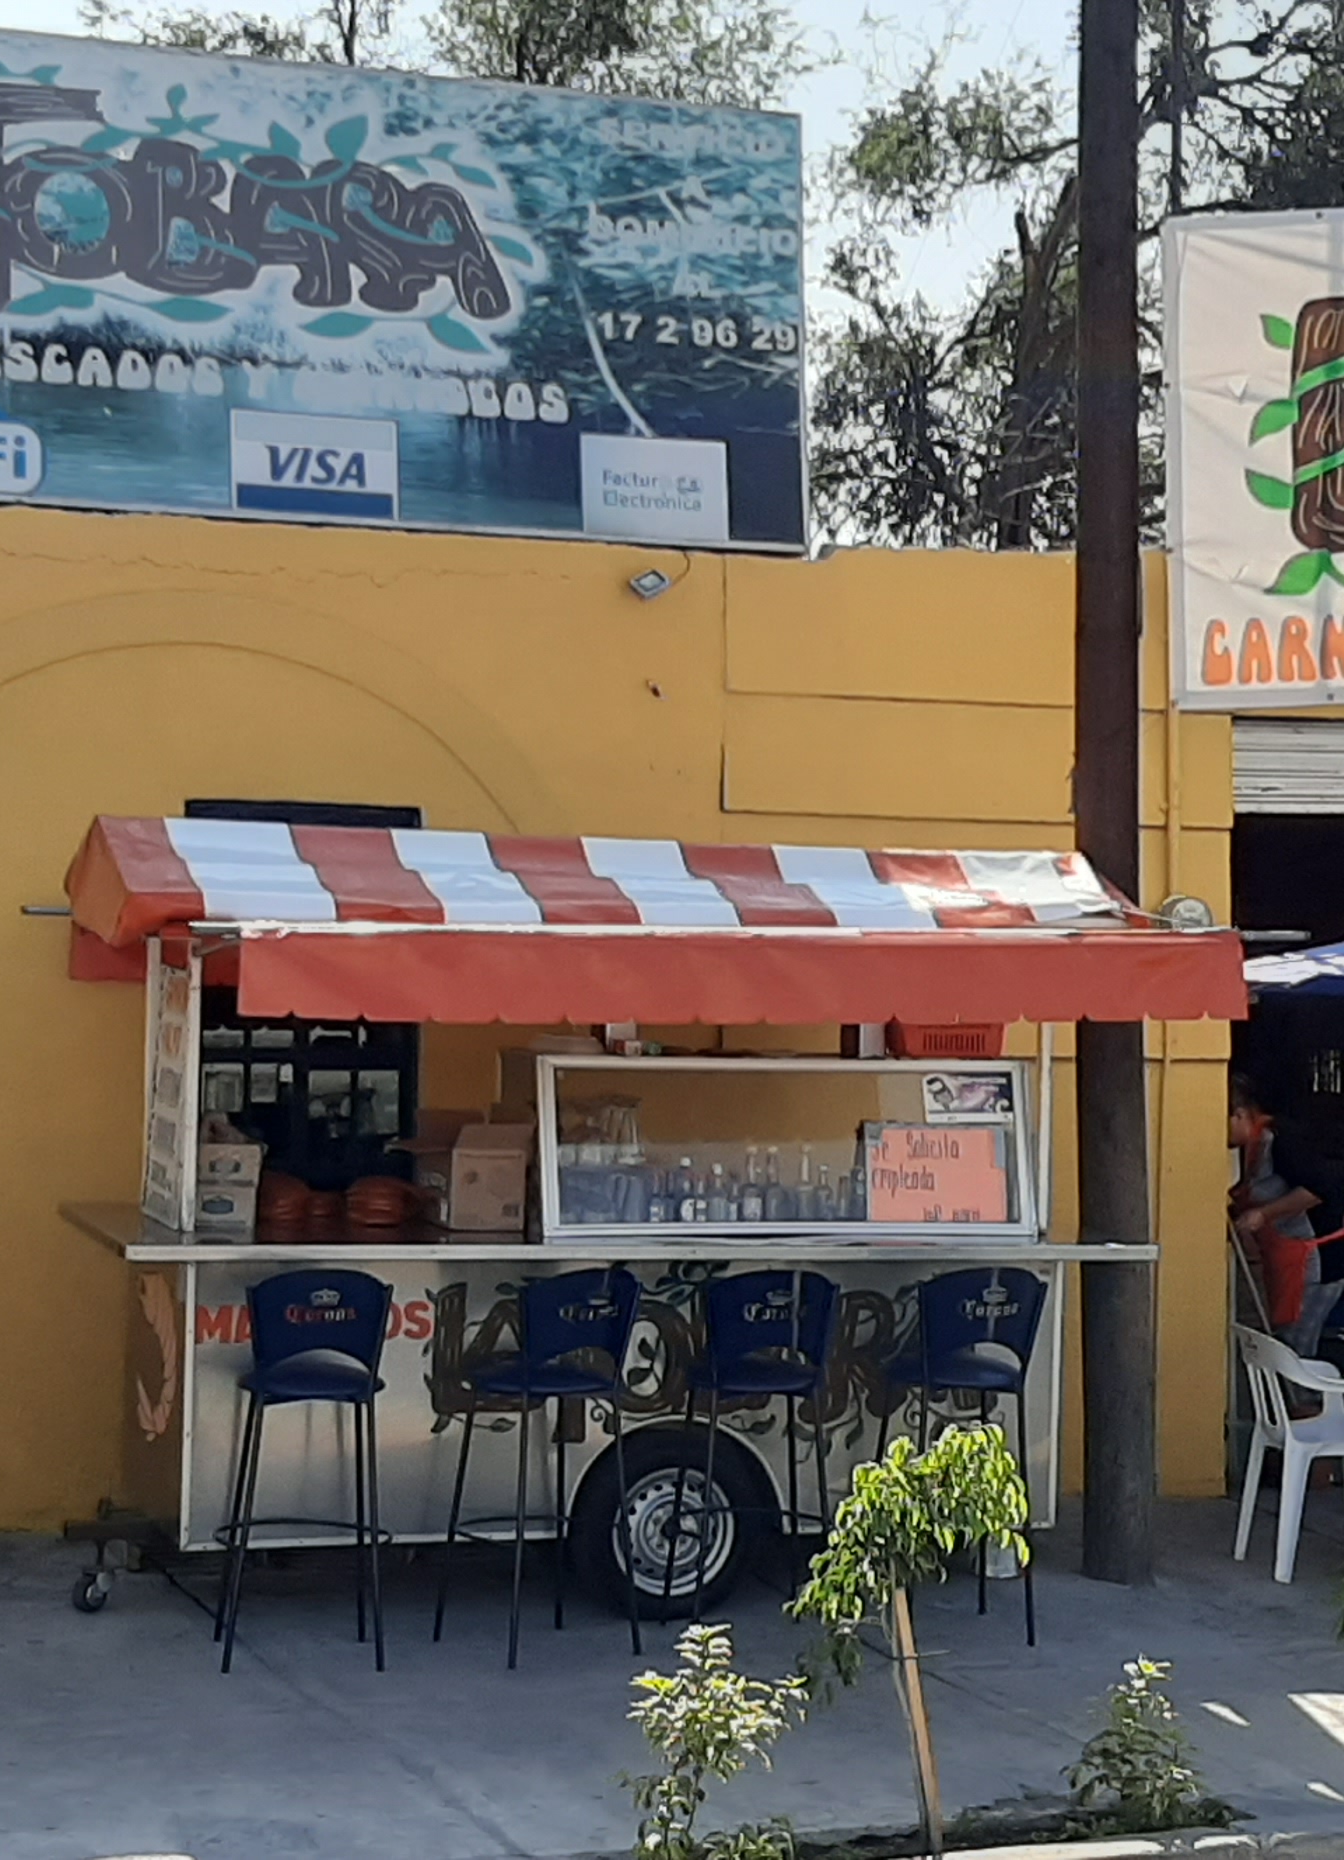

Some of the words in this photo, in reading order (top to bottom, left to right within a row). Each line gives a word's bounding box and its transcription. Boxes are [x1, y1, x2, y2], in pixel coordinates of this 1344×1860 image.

[597, 312, 643, 341] 17
[656, 316, 680, 345] 2
[751, 317, 797, 351] 29
[265, 445, 367, 488] VISA
